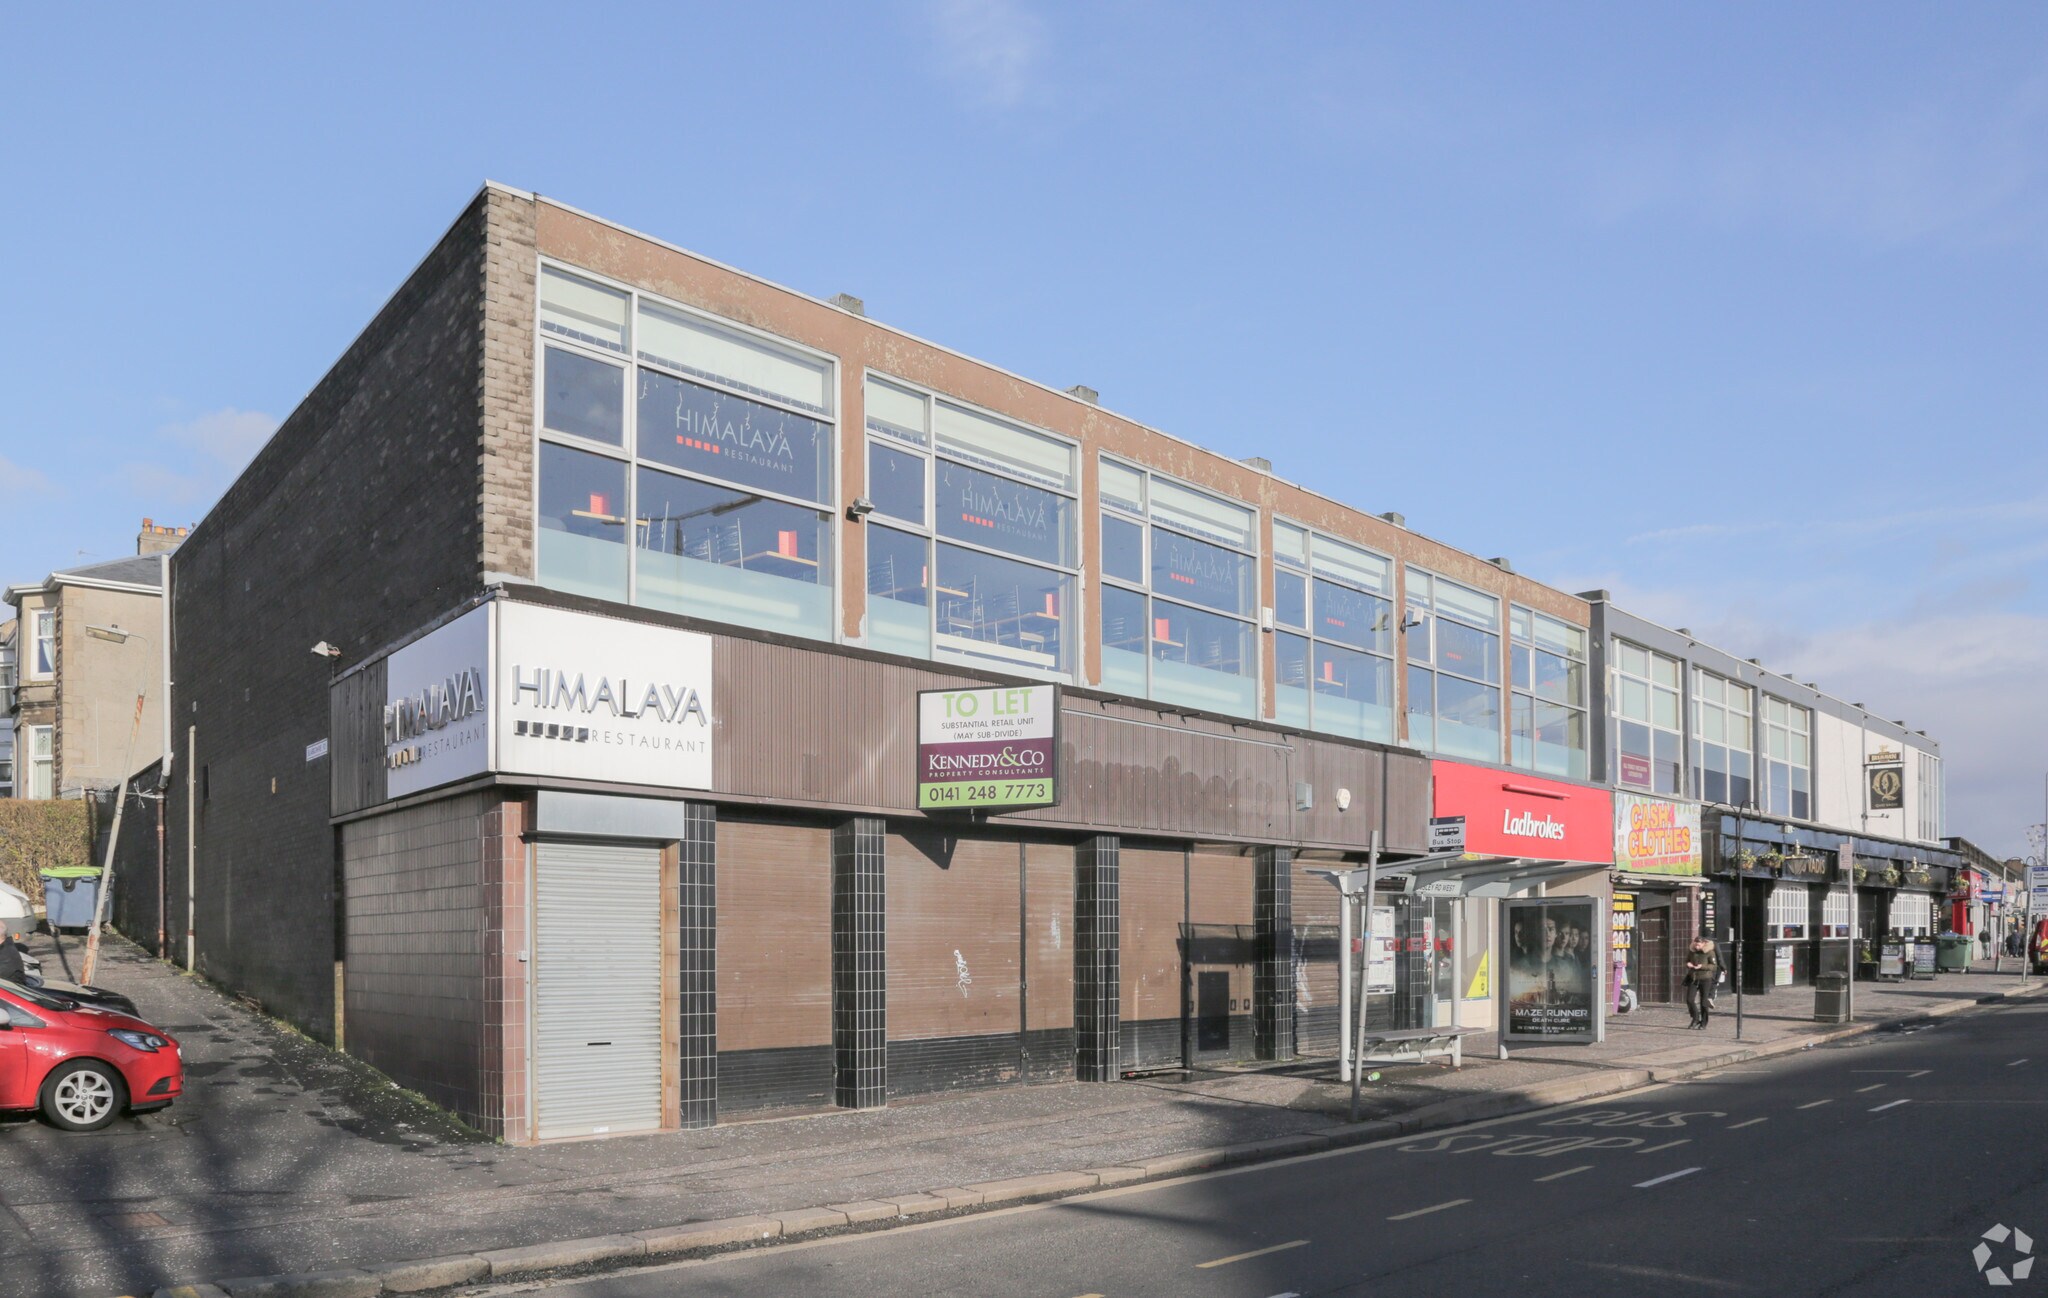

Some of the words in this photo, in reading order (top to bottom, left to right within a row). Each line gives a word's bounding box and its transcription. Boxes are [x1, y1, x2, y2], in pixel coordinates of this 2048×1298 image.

[676, 406, 793, 460] HIMALAYA
[724, 447, 793, 474] RESTAURANT
[962, 488, 1047, 531] HIMALAYA
[1170, 551, 1234, 586] HIMALAYA
[512, 665, 707, 727] HIMALAYA
[942, 693, 979, 718] TO
[992, 689, 1033, 716] LET
[941, 721, 988, 730] SUBSTANTIAL
[991, 719, 1014, 728] RETAIL
[1017, 717, 1034, 726] UNIT
[953, 732, 974, 740] (MAY
[977, 729, 1023, 739] SUB-DIVIDE)
[422, 722, 486, 759] RESTAURANT
[592, 729, 706, 753] RESTAURANT
[978, 767, 1044, 776] CONSULTANTS
[929, 787, 960, 801] 0141
[968, 785, 997, 800] 248
[1005, 784, 1045, 799] 7773
[1503, 808, 1565, 840] Ladbrokes
[1446, 837, 1462, 845] Stop
[1628, 826, 1691, 858] CLOTHES
[1515, 1008, 1543, 1017] MAZE
[1546, 1009, 1588, 1017] RUNNER
[1538, 1111, 1728, 1128] BUS
[1396, 1134, 1646, 1157] STOP
